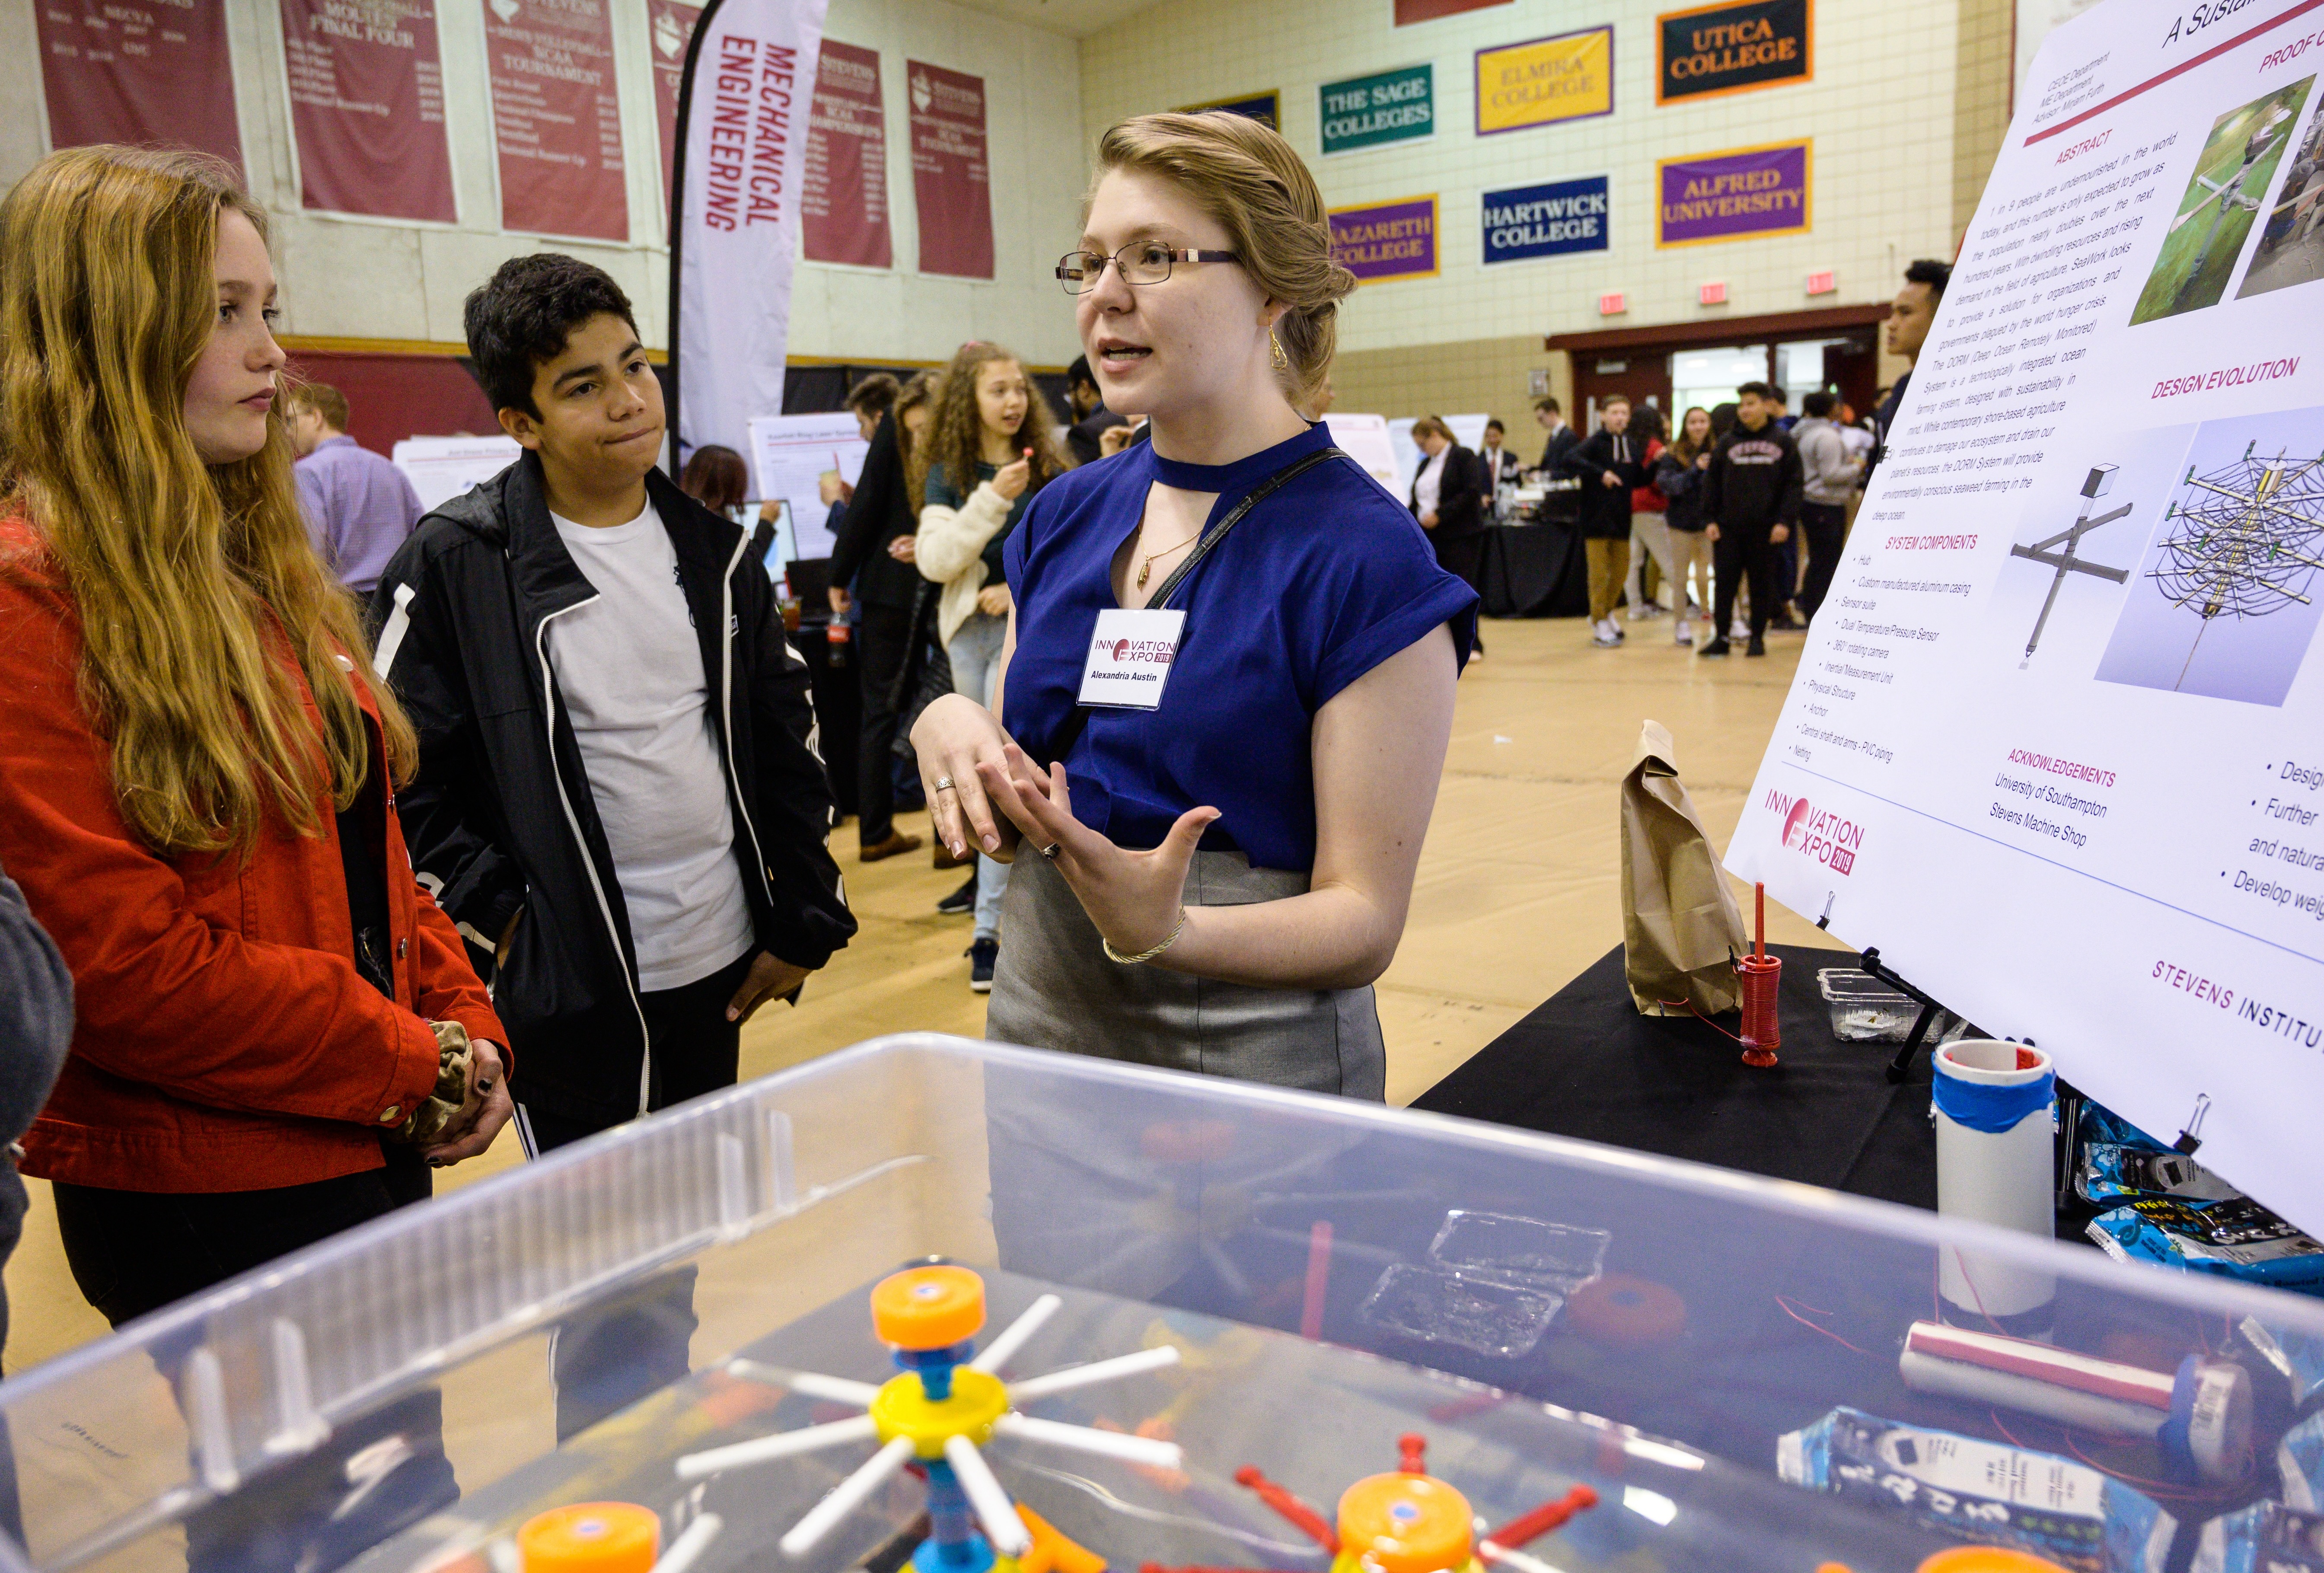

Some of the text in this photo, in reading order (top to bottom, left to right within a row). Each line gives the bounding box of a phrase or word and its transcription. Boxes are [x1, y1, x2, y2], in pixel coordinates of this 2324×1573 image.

[309, 13, 415, 49] FINAL FOUR
[1692, 17, 1775, 52] UTICA
[2162, 16, 2182, 48] A
[504, 53, 602, 86] TOURNAMENT
[1500, 54, 1585, 87] ELMIRA
[1671, 37, 1798, 80] COLLEGE
[2070, 52, 2110, 80] Department
[2259, 33, 2316, 73] PROOF
[1326, 77, 1428, 114] THE SAGE
[1491, 75, 1597, 110] COLLEGE
[2033, 107, 2059, 124] Advisor:
[2088, 83, 2104, 98] Furth
[2041, 75, 2093, 107] ME Department
[706, 35, 757, 232] ENGINEERING
[746, 42, 797, 227] MECHANICAL
[1324, 103, 1431, 140] COLLEGES
[2055, 129, 2112, 166] ABSTRACT
[1683, 168, 1782, 199] ALFRED
[2017, 131, 2178, 209] people undernourished the world
[1484, 193, 1607, 228] HARTWICK
[1662, 188, 1804, 224] UNIVERSITY
[1981, 162, 2165, 239] today, number expected grow as
[1491, 217, 1599, 249] COLLEGE
[1989, 187, 2155, 258] population doubles over the next
[1965, 216, 2143, 283] hundred years. dwindling resources and rising
[1956, 242, 2132, 306] demand agriculture, SeaWork looks
[1960, 266, 2122, 325] provide solution organizations and
[1938, 297, 2107, 352] governments plagued world hunger crisis.
[1947, 320, 2097, 368] DORM (Deep Ocean Remotely Monitored)
[1924, 348, 2086, 393] System technologically integrated ocean
[2151, 356, 2300, 399] DESIGN EVOLUTION
[1939, 376, 2064, 412] system, designed with sustainability
[1924, 401, 2066, 432] While contemporary shore-based agriculture
[1900, 427, 2055, 457] continues damage ecosystem and drain our
[1913, 451, 2043, 475] resources, DORM System provide
[1882, 477, 2032, 499] environmentally conscious seaweed farming the
[1872, 511, 1905, 521] deep ocean.
[1885, 534, 1978, 550] SYSTEM COMPONENTS
[1860, 556, 1871, 565] Hub
[1841, 597, 1876, 610] Sensor suite
[1859, 576, 1971, 597] Custom manufactured aluminum casing
[1841, 619, 1939, 641] Dual Temperature/Pressure Sensor
[1155, 654, 1169, 662] 2019
[1849, 645, 1868, 658] rotating
[1868, 648, 1889, 658] camera
[1091, 671, 1157, 682] Alexandria Austin
[1809, 680, 1855, 700] Physical Structure
[1825, 664, 1893, 684] Inertial Measurement Unit
[1810, 704, 1828, 716] Anchor
[1801, 727, 1893, 764] Central shaft and arms PVC piping
[2008, 748, 2116, 788] ACKNOWLEDGEMENTS
[1995, 772, 2107, 818] University of Southampton
[2265, 798, 2319, 826] Further
[1990, 802, 2087, 848] Stevens Machine Shop
[1832, 849, 1852, 872] 2019
[2249, 838, 2279, 857] and
[2234, 870, 2292, 907] Develop
[2152, 960, 2324, 1053] STEVENS INSTITU
